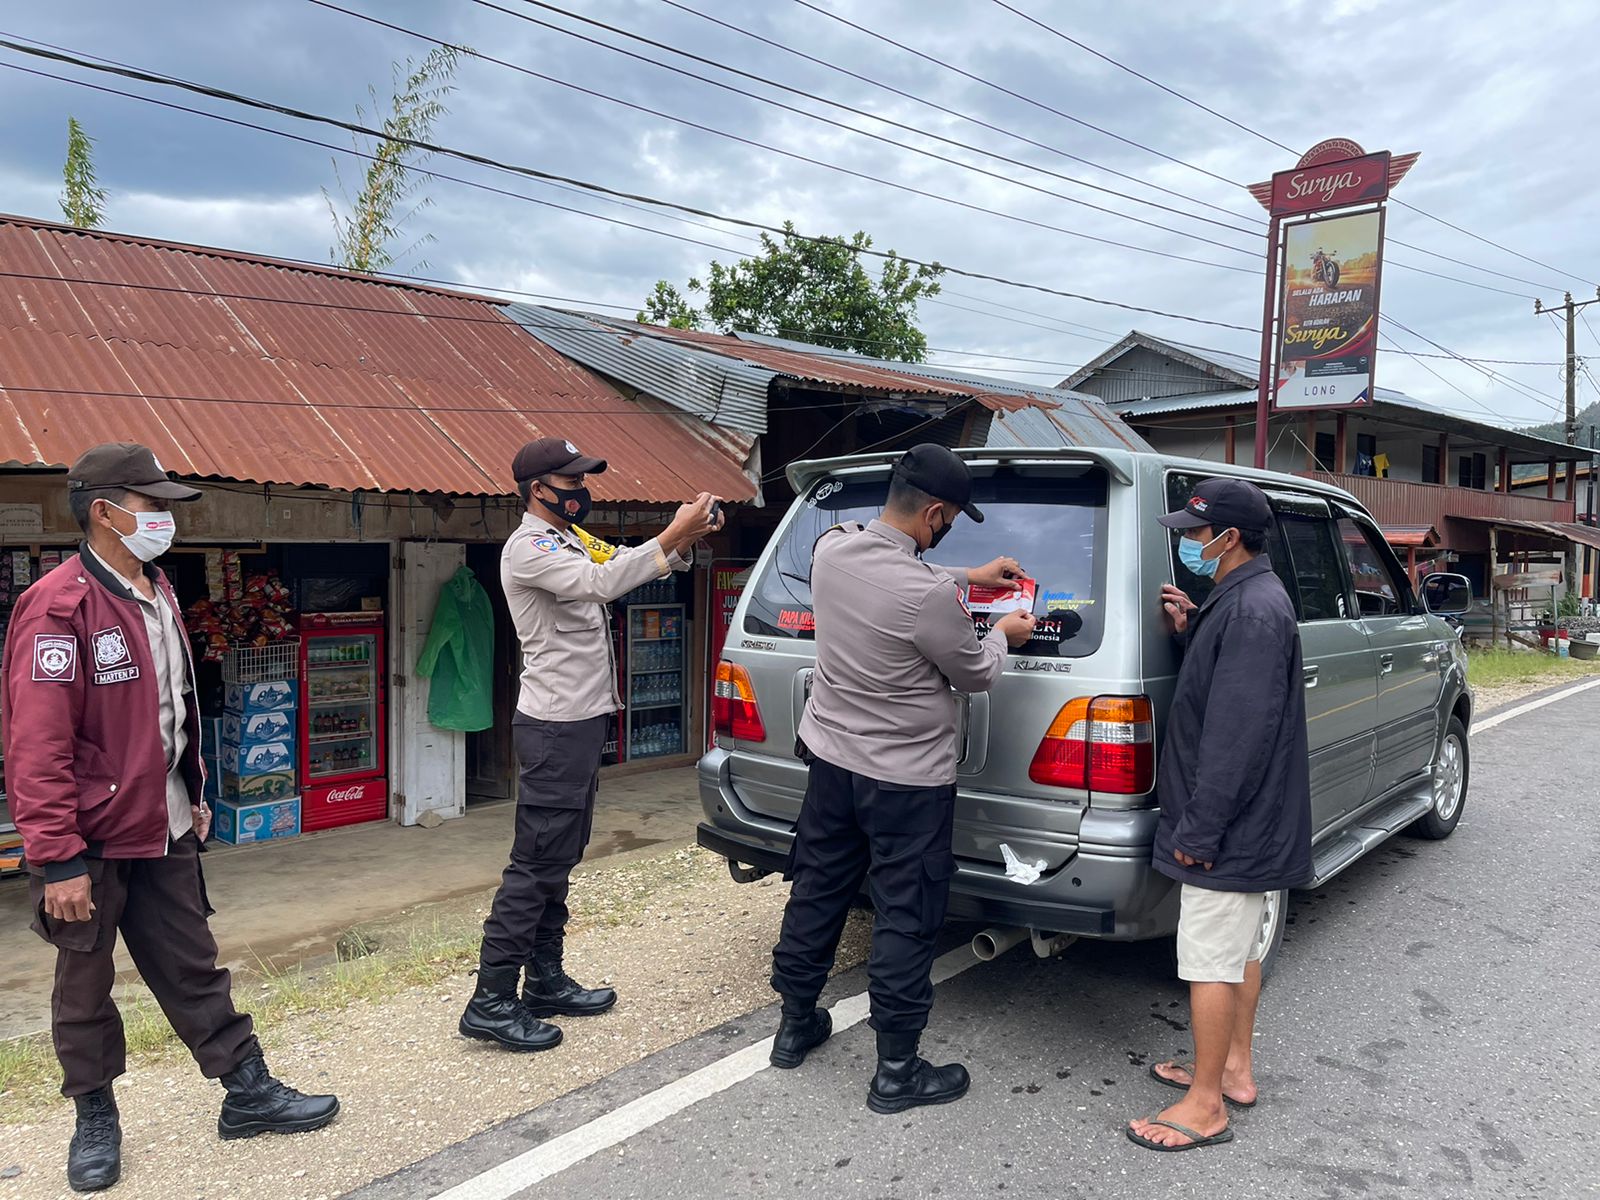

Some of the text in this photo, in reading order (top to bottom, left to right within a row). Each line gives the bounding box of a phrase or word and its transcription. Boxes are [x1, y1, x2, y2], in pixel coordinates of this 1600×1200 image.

[1287, 171, 1361, 202] Surya
[1309, 289, 1362, 306] HARAPAN
[1285, 325, 1347, 350] Surya
[1304, 385, 1336, 396] LONG
[99, 670, 128, 683] MARTEN
